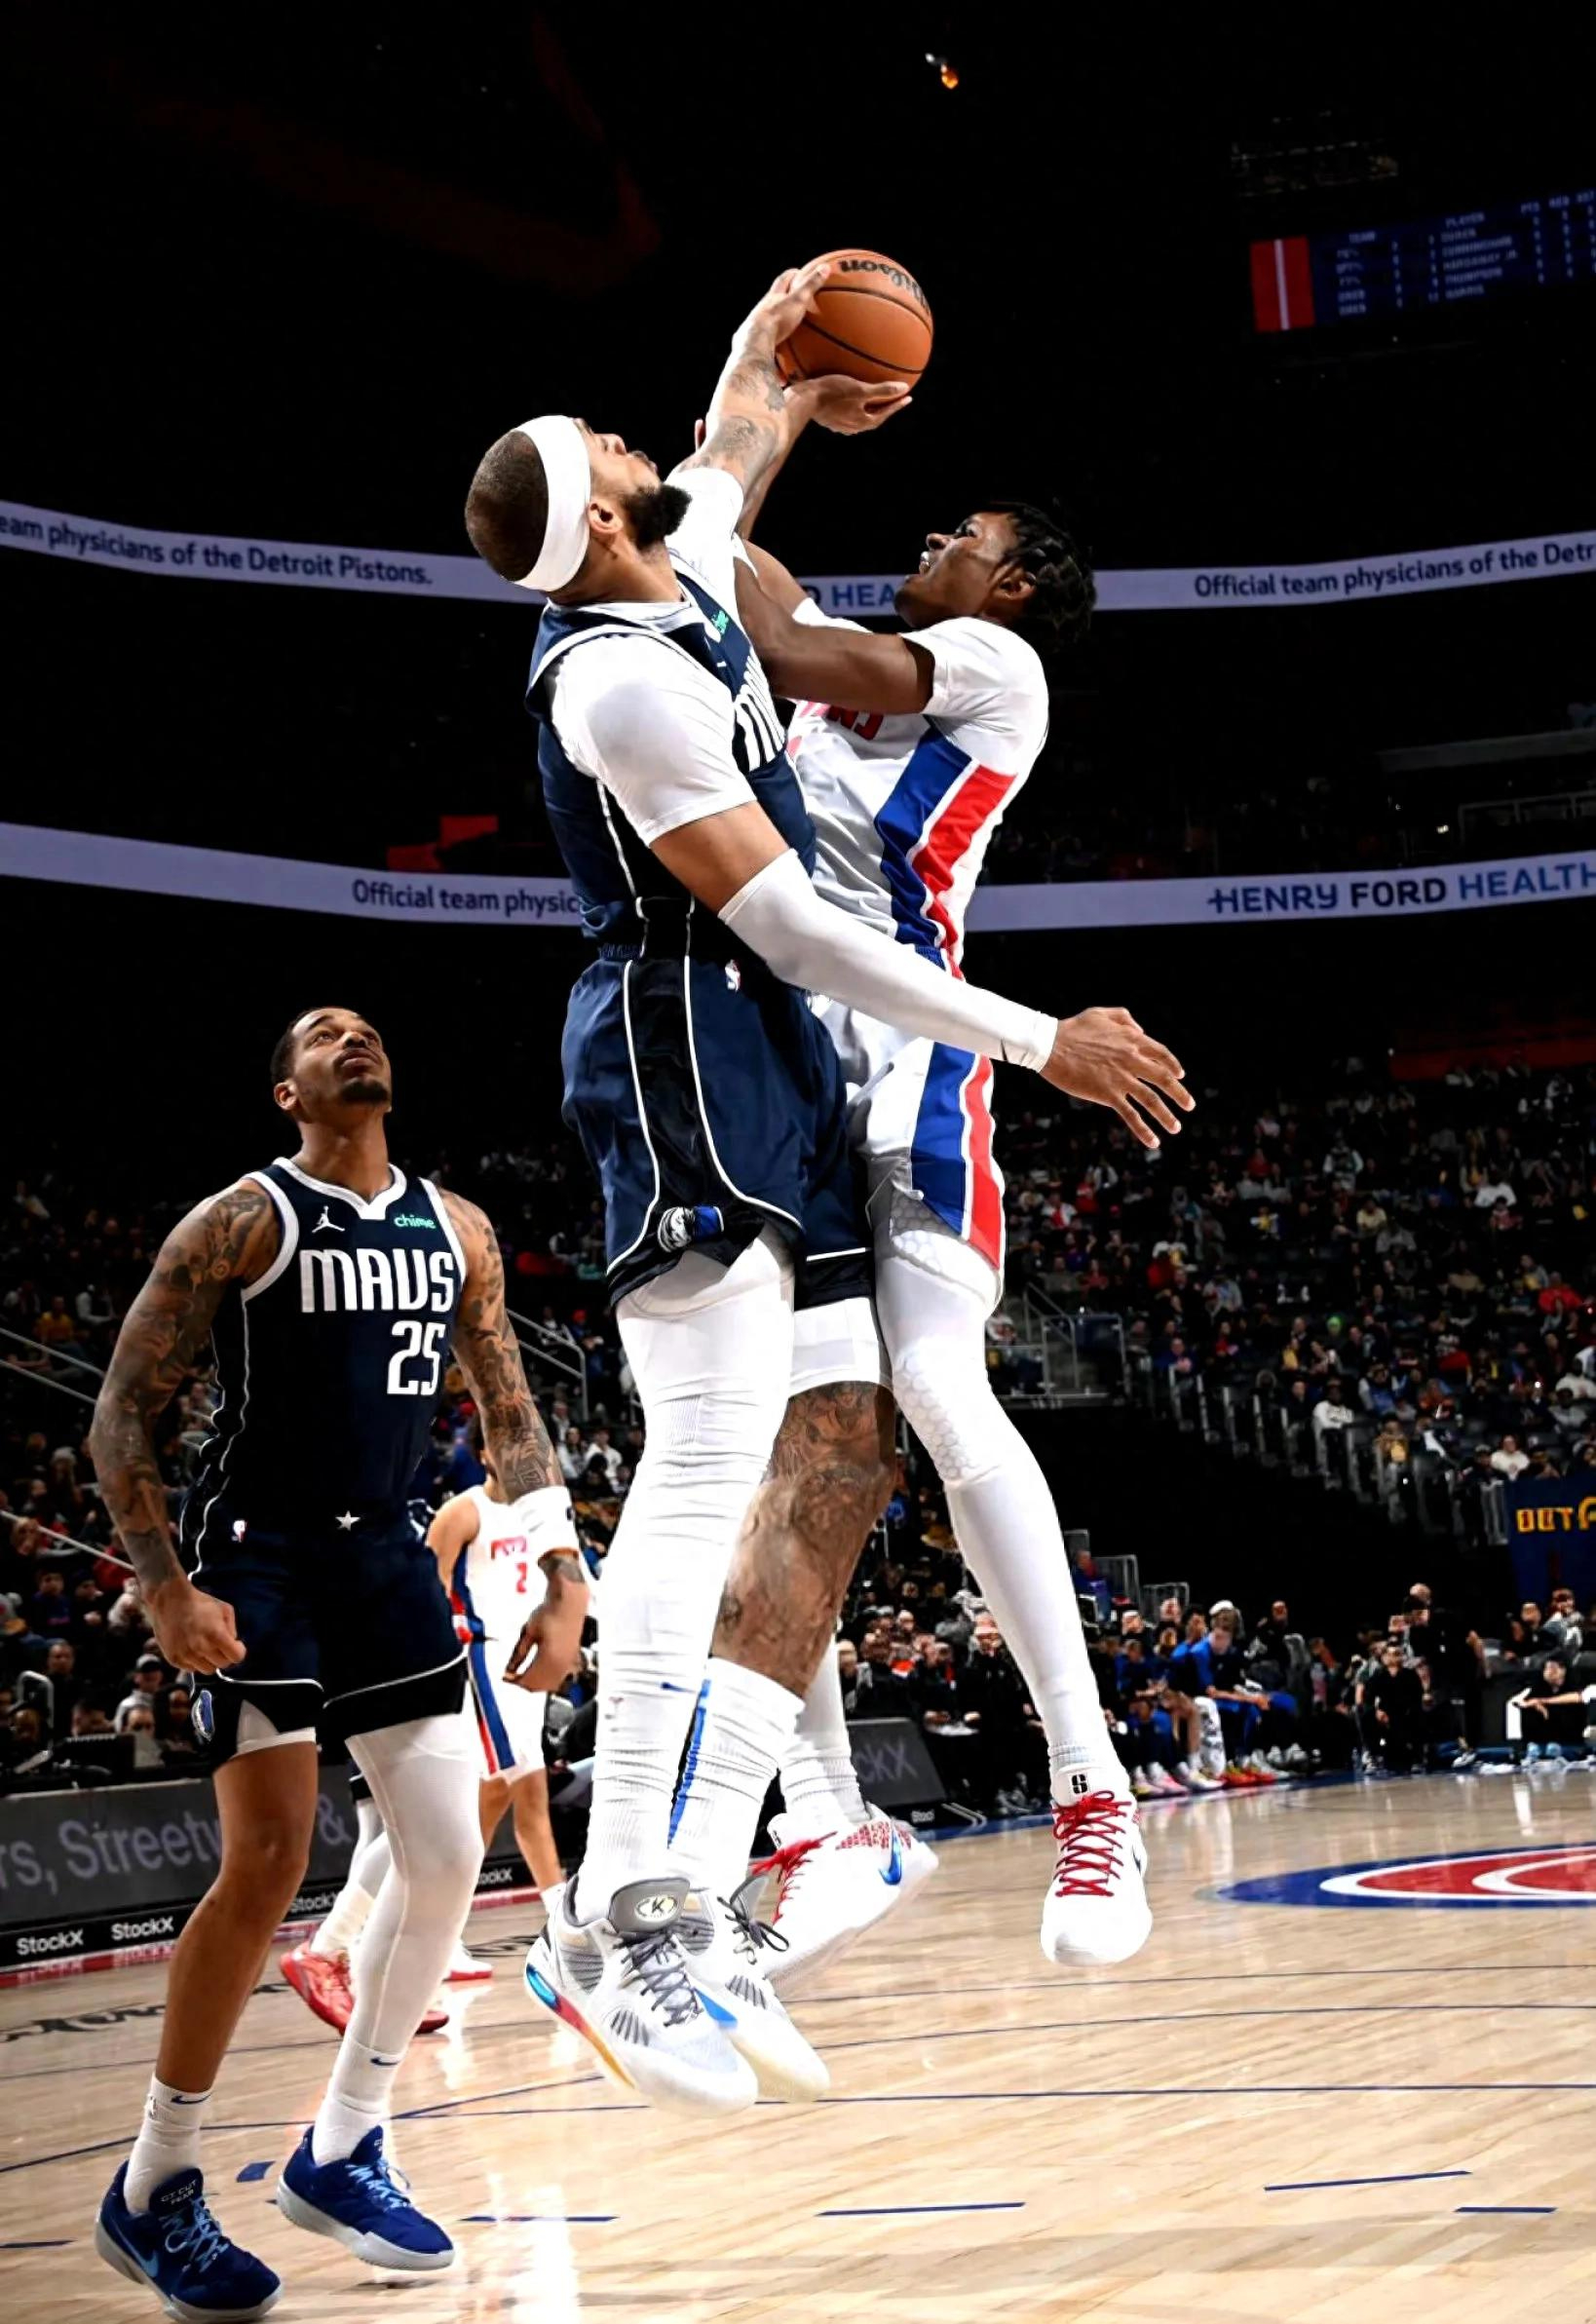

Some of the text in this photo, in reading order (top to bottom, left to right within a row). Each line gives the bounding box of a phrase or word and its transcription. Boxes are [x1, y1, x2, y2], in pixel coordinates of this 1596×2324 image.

[48, 519, 165, 563] physicians
[171, 541, 197, 565] of
[203, 545, 243, 570] the
[247, 546, 334, 577] Detroit
[339, 553, 433, 585] Pistons.
[1195, 573, 1276, 597] Official
[1280, 574, 1338, 595] team
[1344, 559, 1464, 595] physicians
[1468, 550, 1495, 575] of
[1499, 548, 1539, 571] the
[352, 879, 435, 909] Official
[440, 889, 500, 911] team
[1207, 883, 1339, 914] HENRY
[1350, 877, 1447, 908] FORD
[394, 1214, 437, 1230] chime
[299, 1248, 455, 1314] MAVS
[387, 1320, 446, 1395] 25
[17, 1929, 85, 1956] StockX
[110, 1916, 174, 1941] StockX
